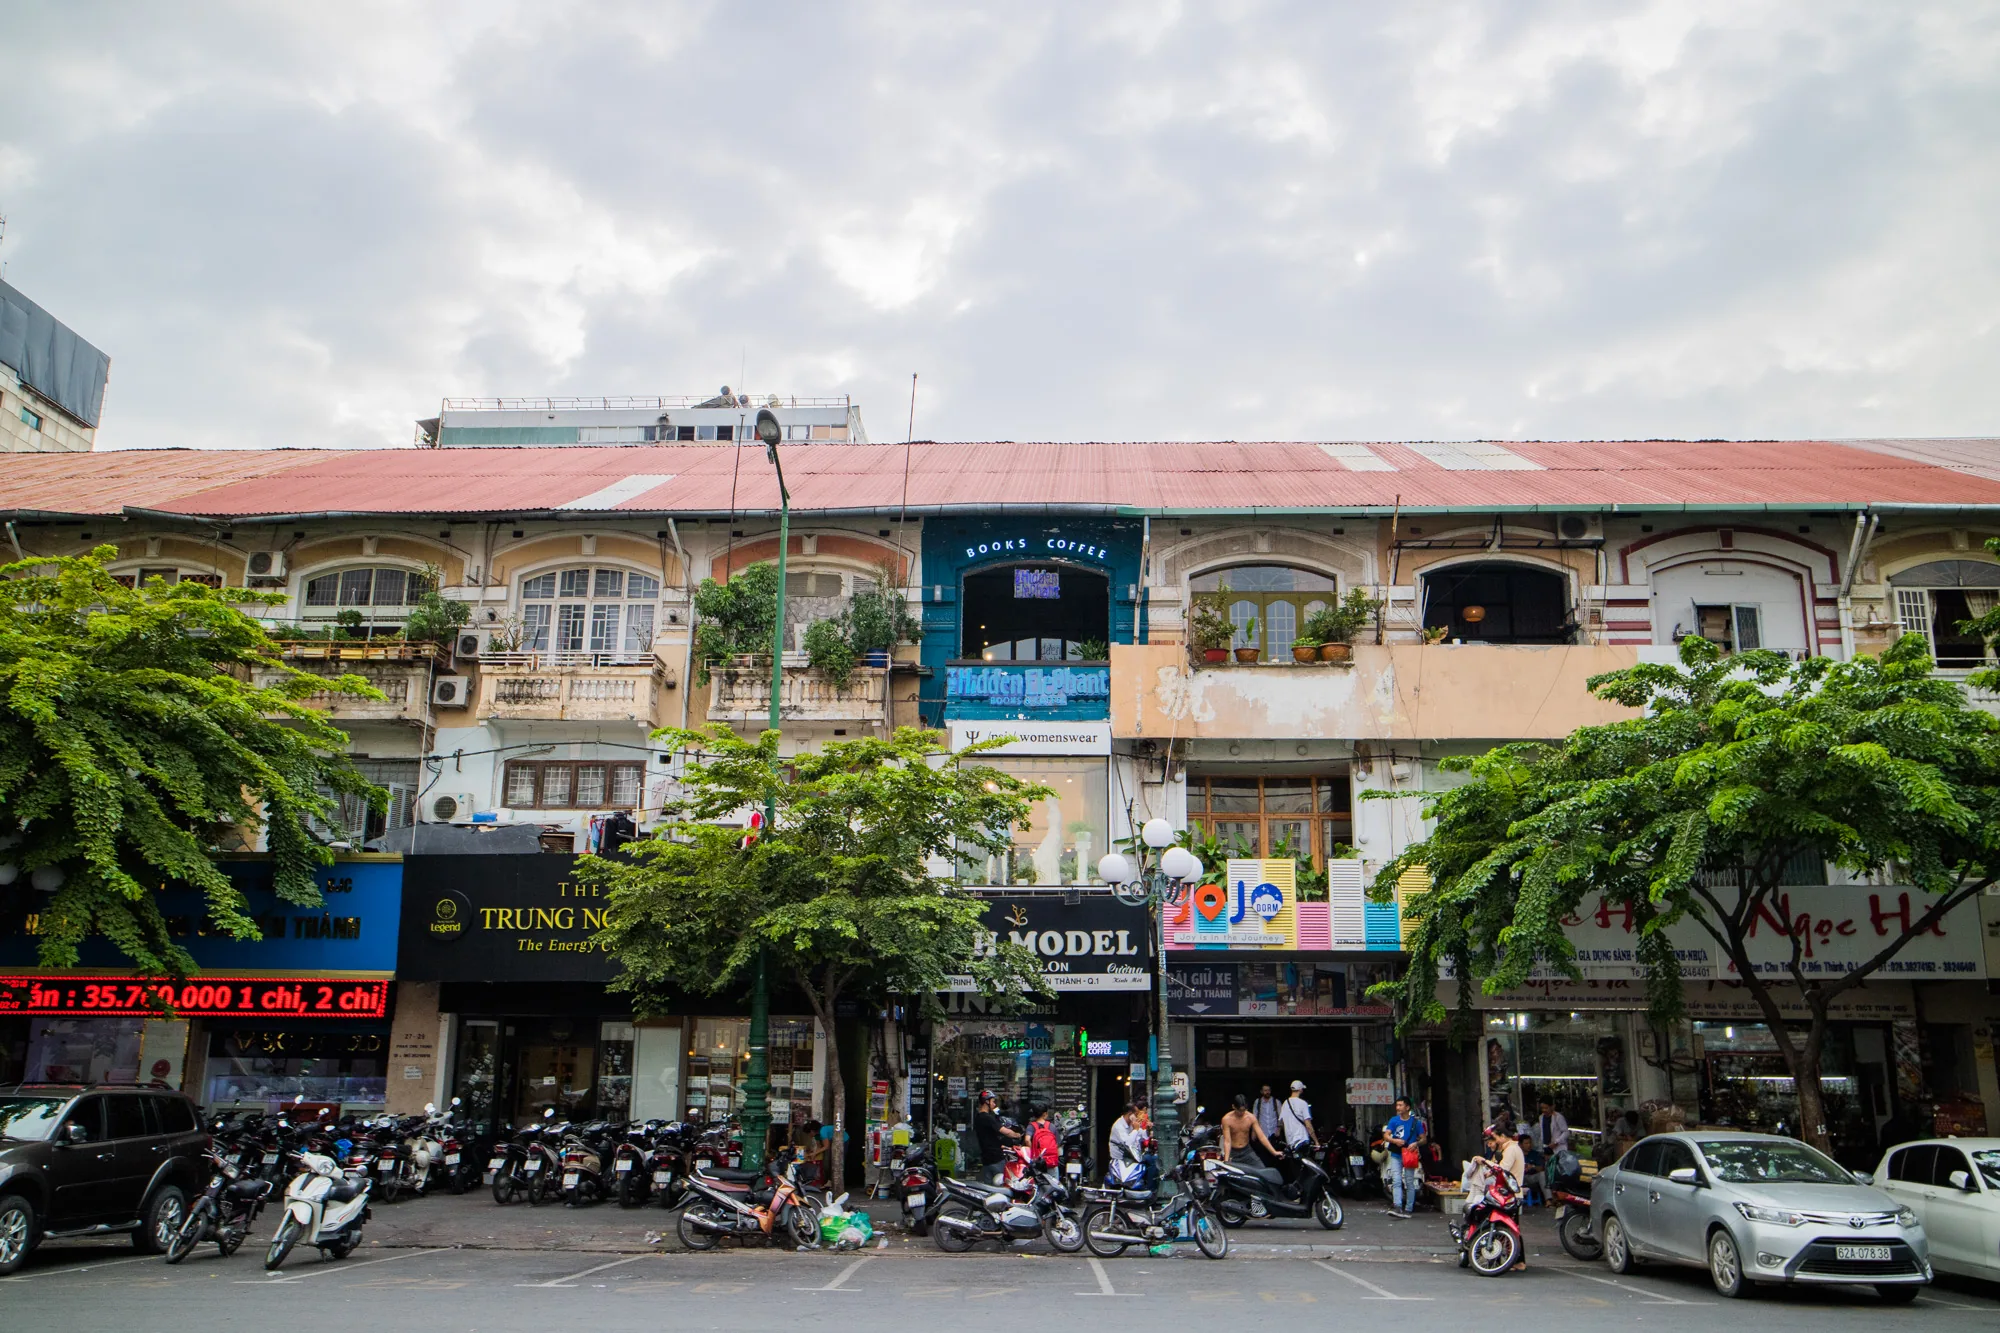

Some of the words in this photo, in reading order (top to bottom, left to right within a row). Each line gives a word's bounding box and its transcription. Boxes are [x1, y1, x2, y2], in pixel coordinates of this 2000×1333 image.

[966, 538, 1026, 558] BOOKS
[1047, 539, 1106, 559] COFFEE
[958, 668, 1024, 695] Hidden
[1020, 734, 1098, 743] womenswear
[558, 882, 600, 897] THE
[1256, 903, 1279, 912] DORM
[480, 907, 576, 930] TRUNG
[430, 922, 461, 934] Legend
[1750, 893, 1857, 957] Ngọc
[1008, 930, 1138, 956] MODEL
[1180, 934, 1196, 942] Joy
[1241, 934, 1280, 943] Journey
[518, 939, 543, 951] The
[548, 939, 596, 954] Energy
[1579, 950, 1591, 961] GIA
[1592, 950, 1612, 964] DỤNG
[1764, 962, 1778, 972] Chu
[1055, 975, 1082, 986] THÀNH
[1087, 977, 1099, 986] Q.1
[1217, 972, 1232, 985] XE
[238, 986, 254, 1009] 1
[315, 986, 333, 1010] 2
[1204, 987, 1232, 998] THÀNH
[1021, 1003, 1060, 1015] MODEL
[816, 1031, 826, 1040] 33
[1087, 1041, 1112, 1049] BOOKS
[1376, 1094, 1392, 1104] XE
[1816, 1124, 1827, 1135] 15
